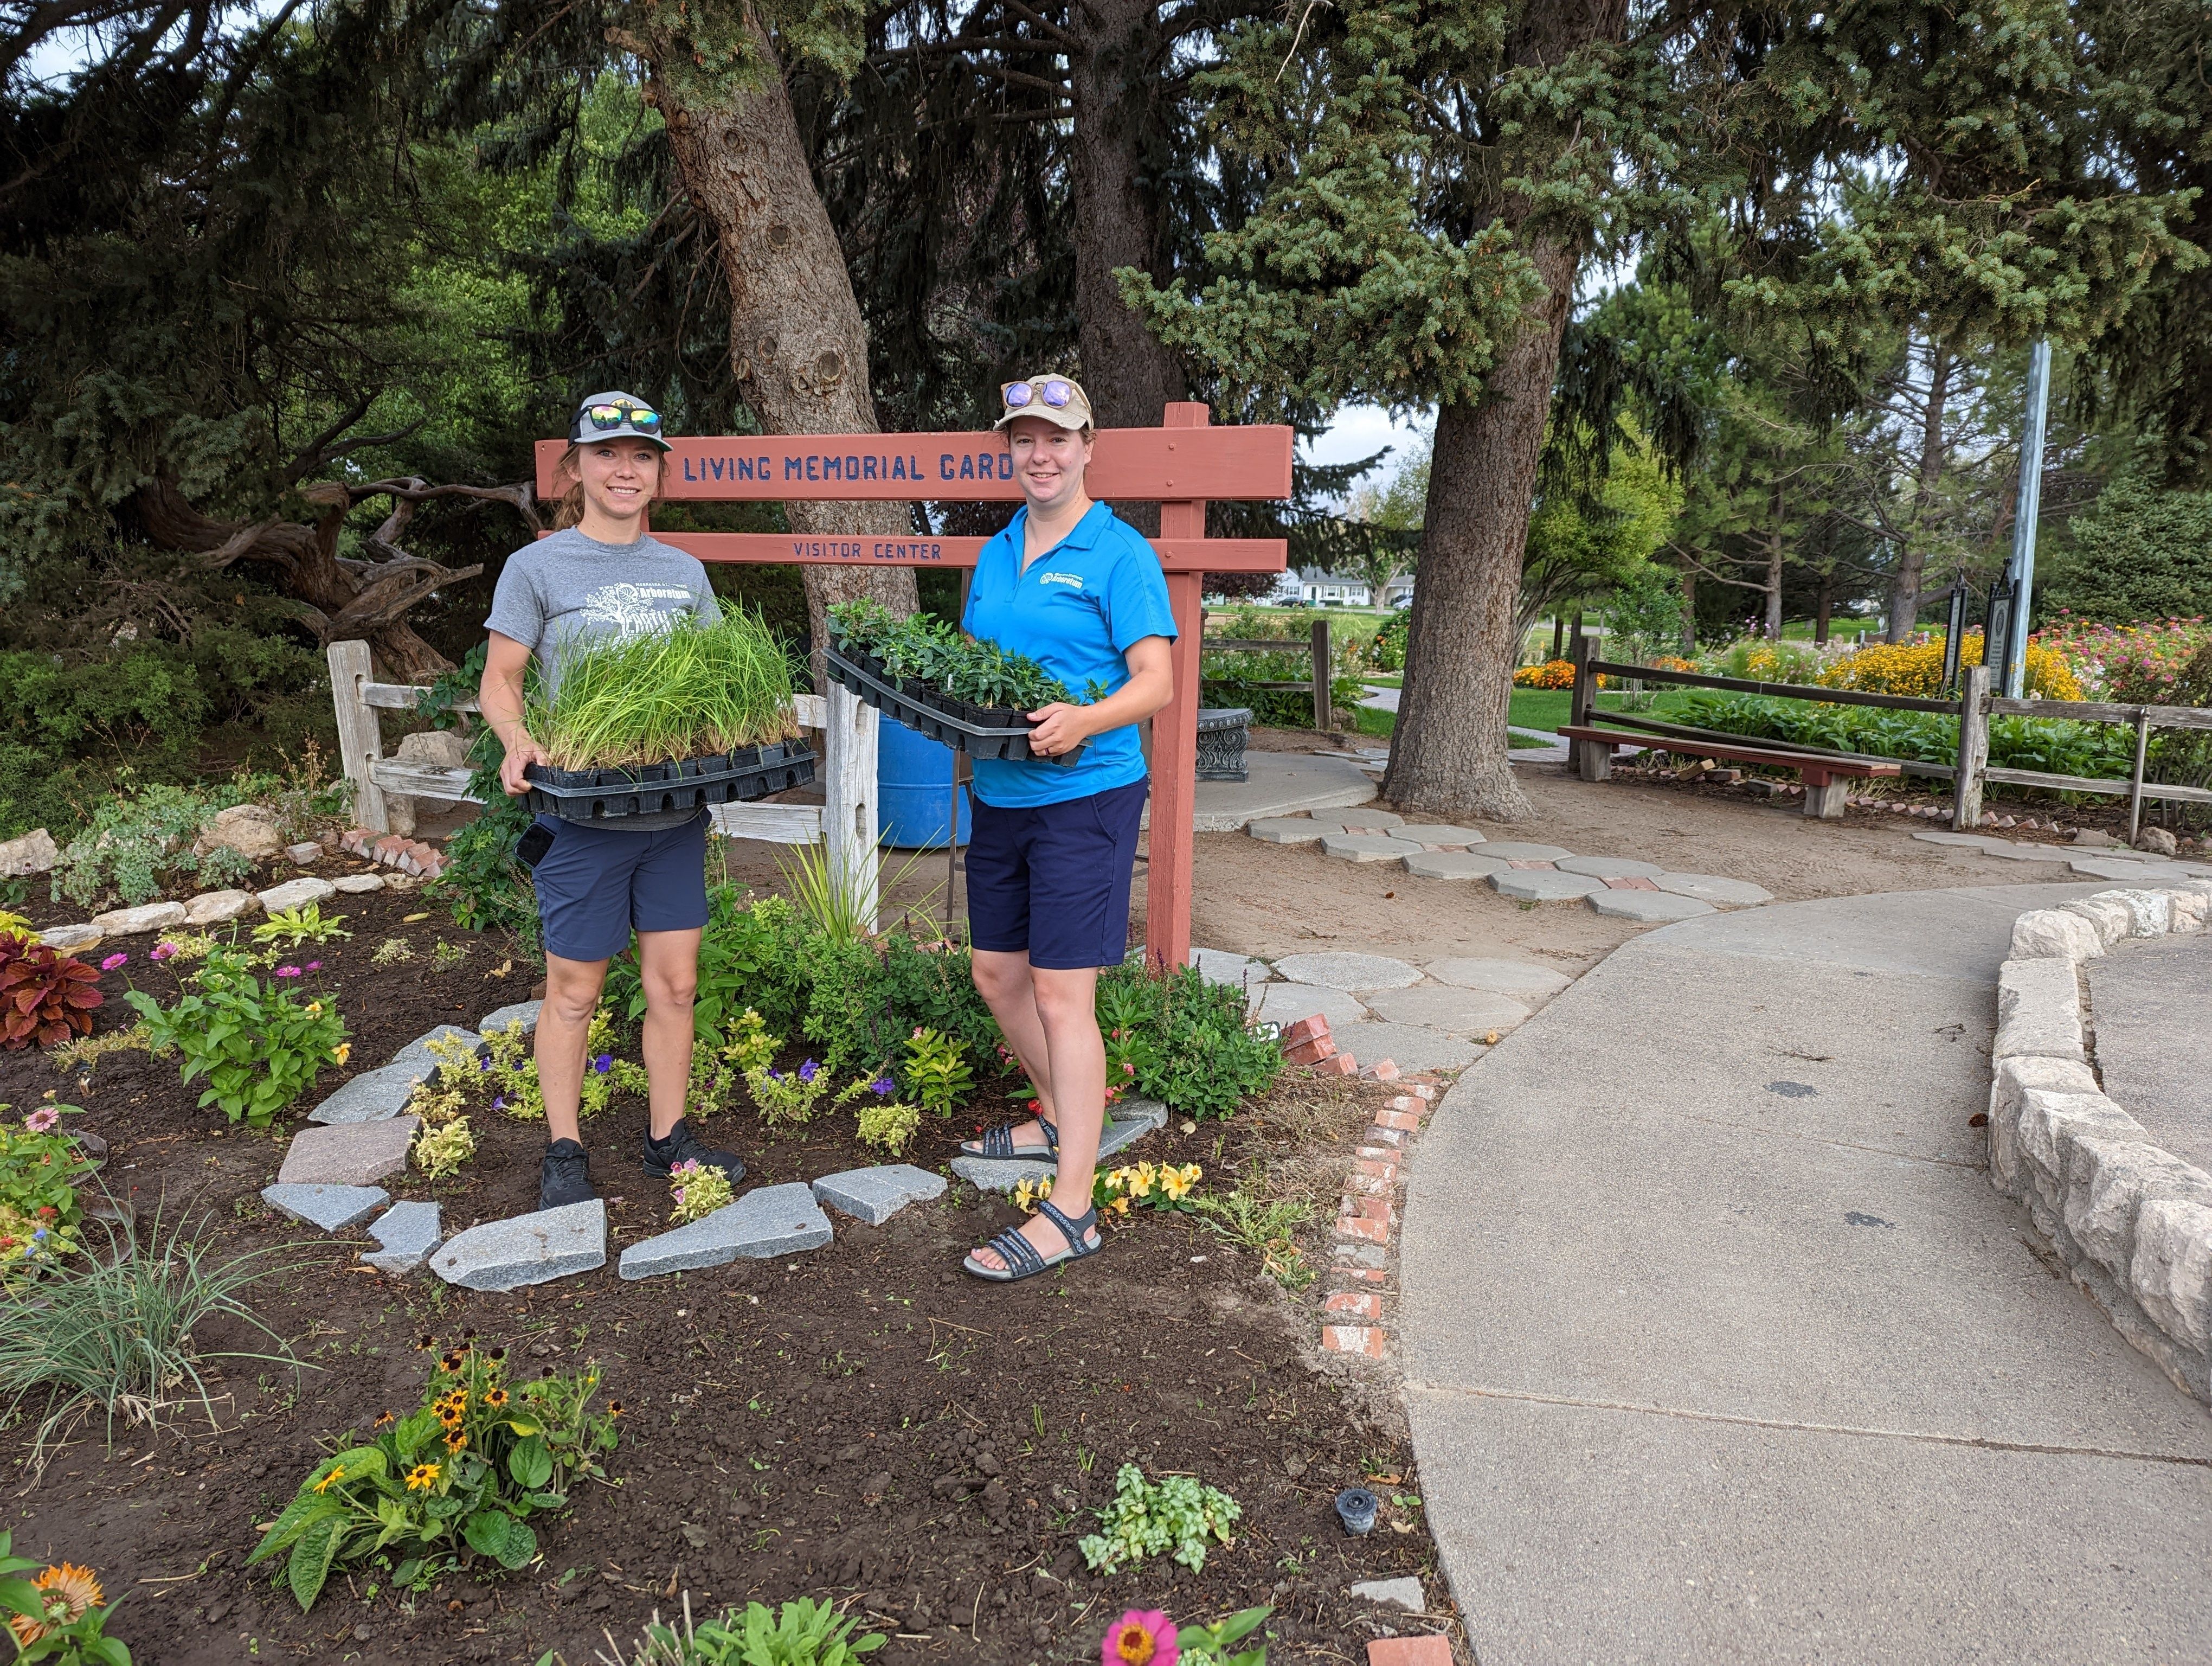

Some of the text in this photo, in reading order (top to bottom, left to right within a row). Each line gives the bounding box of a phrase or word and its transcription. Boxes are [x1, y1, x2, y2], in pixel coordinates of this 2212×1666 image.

[684, 457, 770, 481] LIVING
[785, 456, 924, 480] MEMORIAL
[793, 542, 941, 560] VISITOR CENTER
[1051, 575, 1083, 589] Arboretum
[640, 587, 691, 599] Arboretum
